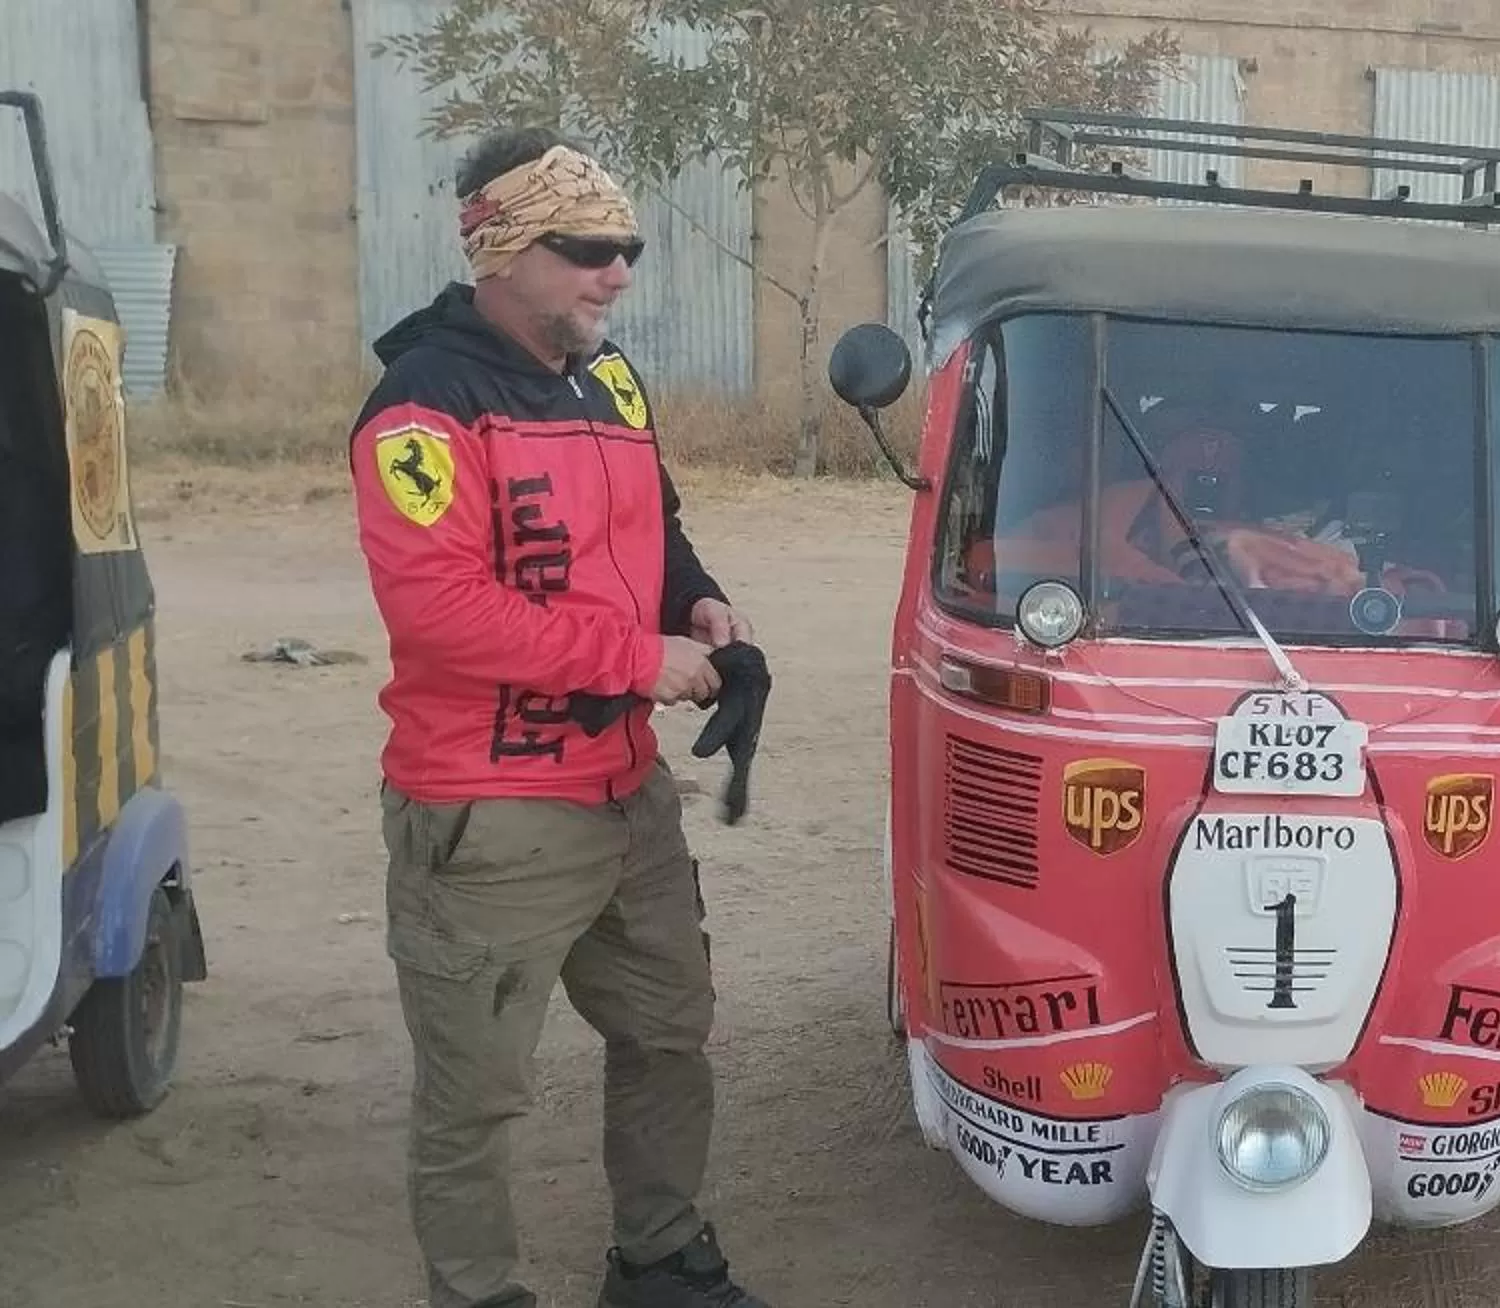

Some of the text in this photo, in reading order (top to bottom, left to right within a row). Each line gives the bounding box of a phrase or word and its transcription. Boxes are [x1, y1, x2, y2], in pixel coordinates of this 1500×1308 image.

[489, 471, 574, 765] Feari
[1252, 697, 1323, 717] SKF
[1067, 785, 1141, 847] ups
[1195, 815, 1355, 850] Marlboro
[1427, 795, 1487, 853] ups
[1264, 893, 1298, 1008] 1
[983, 1065, 1042, 1102] Shell
[1031, 1120, 1100, 1143] MILLE
